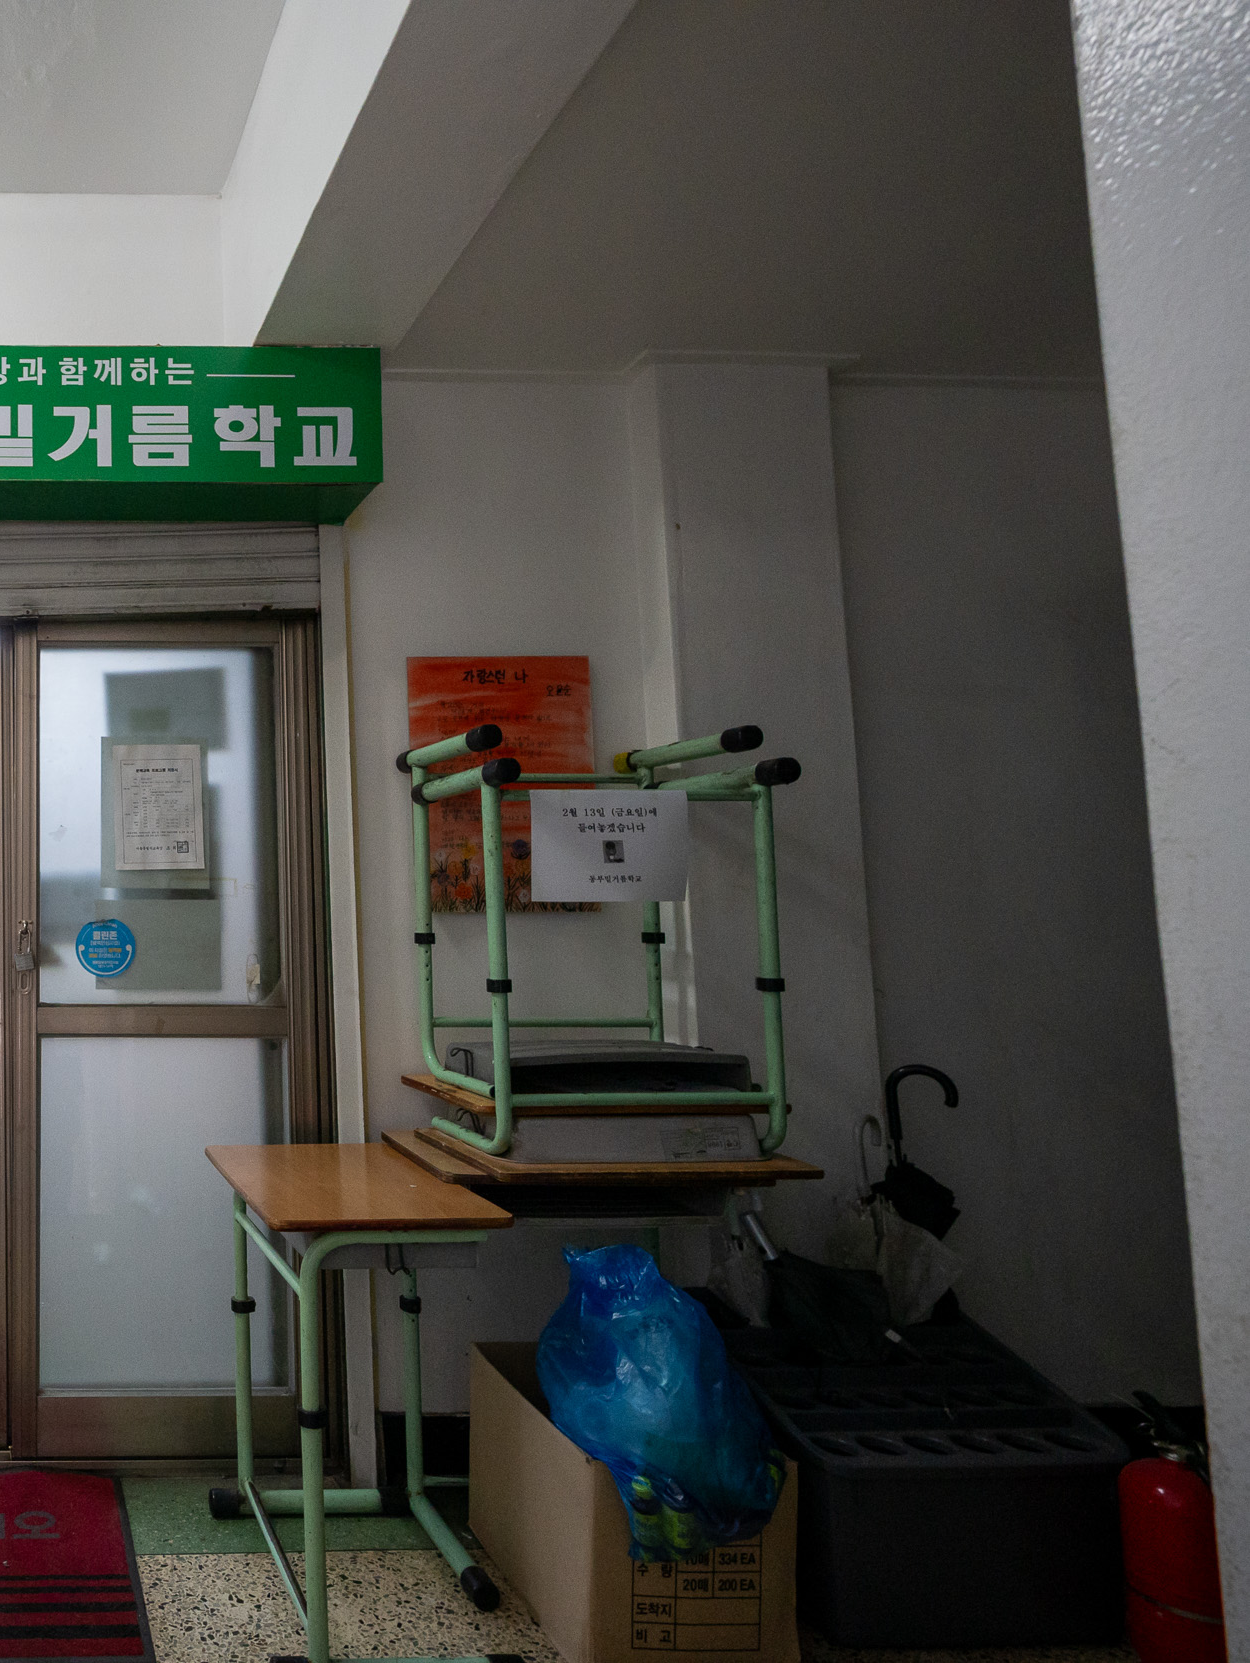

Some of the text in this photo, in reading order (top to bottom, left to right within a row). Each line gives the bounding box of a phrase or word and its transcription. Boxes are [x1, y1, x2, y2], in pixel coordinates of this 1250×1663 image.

[58, 357, 195, 386] 함께하는
[462, 667, 529, 685] 자랑스런 나
[562, 807, 658, 818] 2월 13일 (금요일)에
[718, 1553, 738, 1565] 334
[740, 1553, 756, 1565] EA
[682, 1578, 756, 1592] 20매 200 EA
[635, 1602, 672, 1617] 도착지
